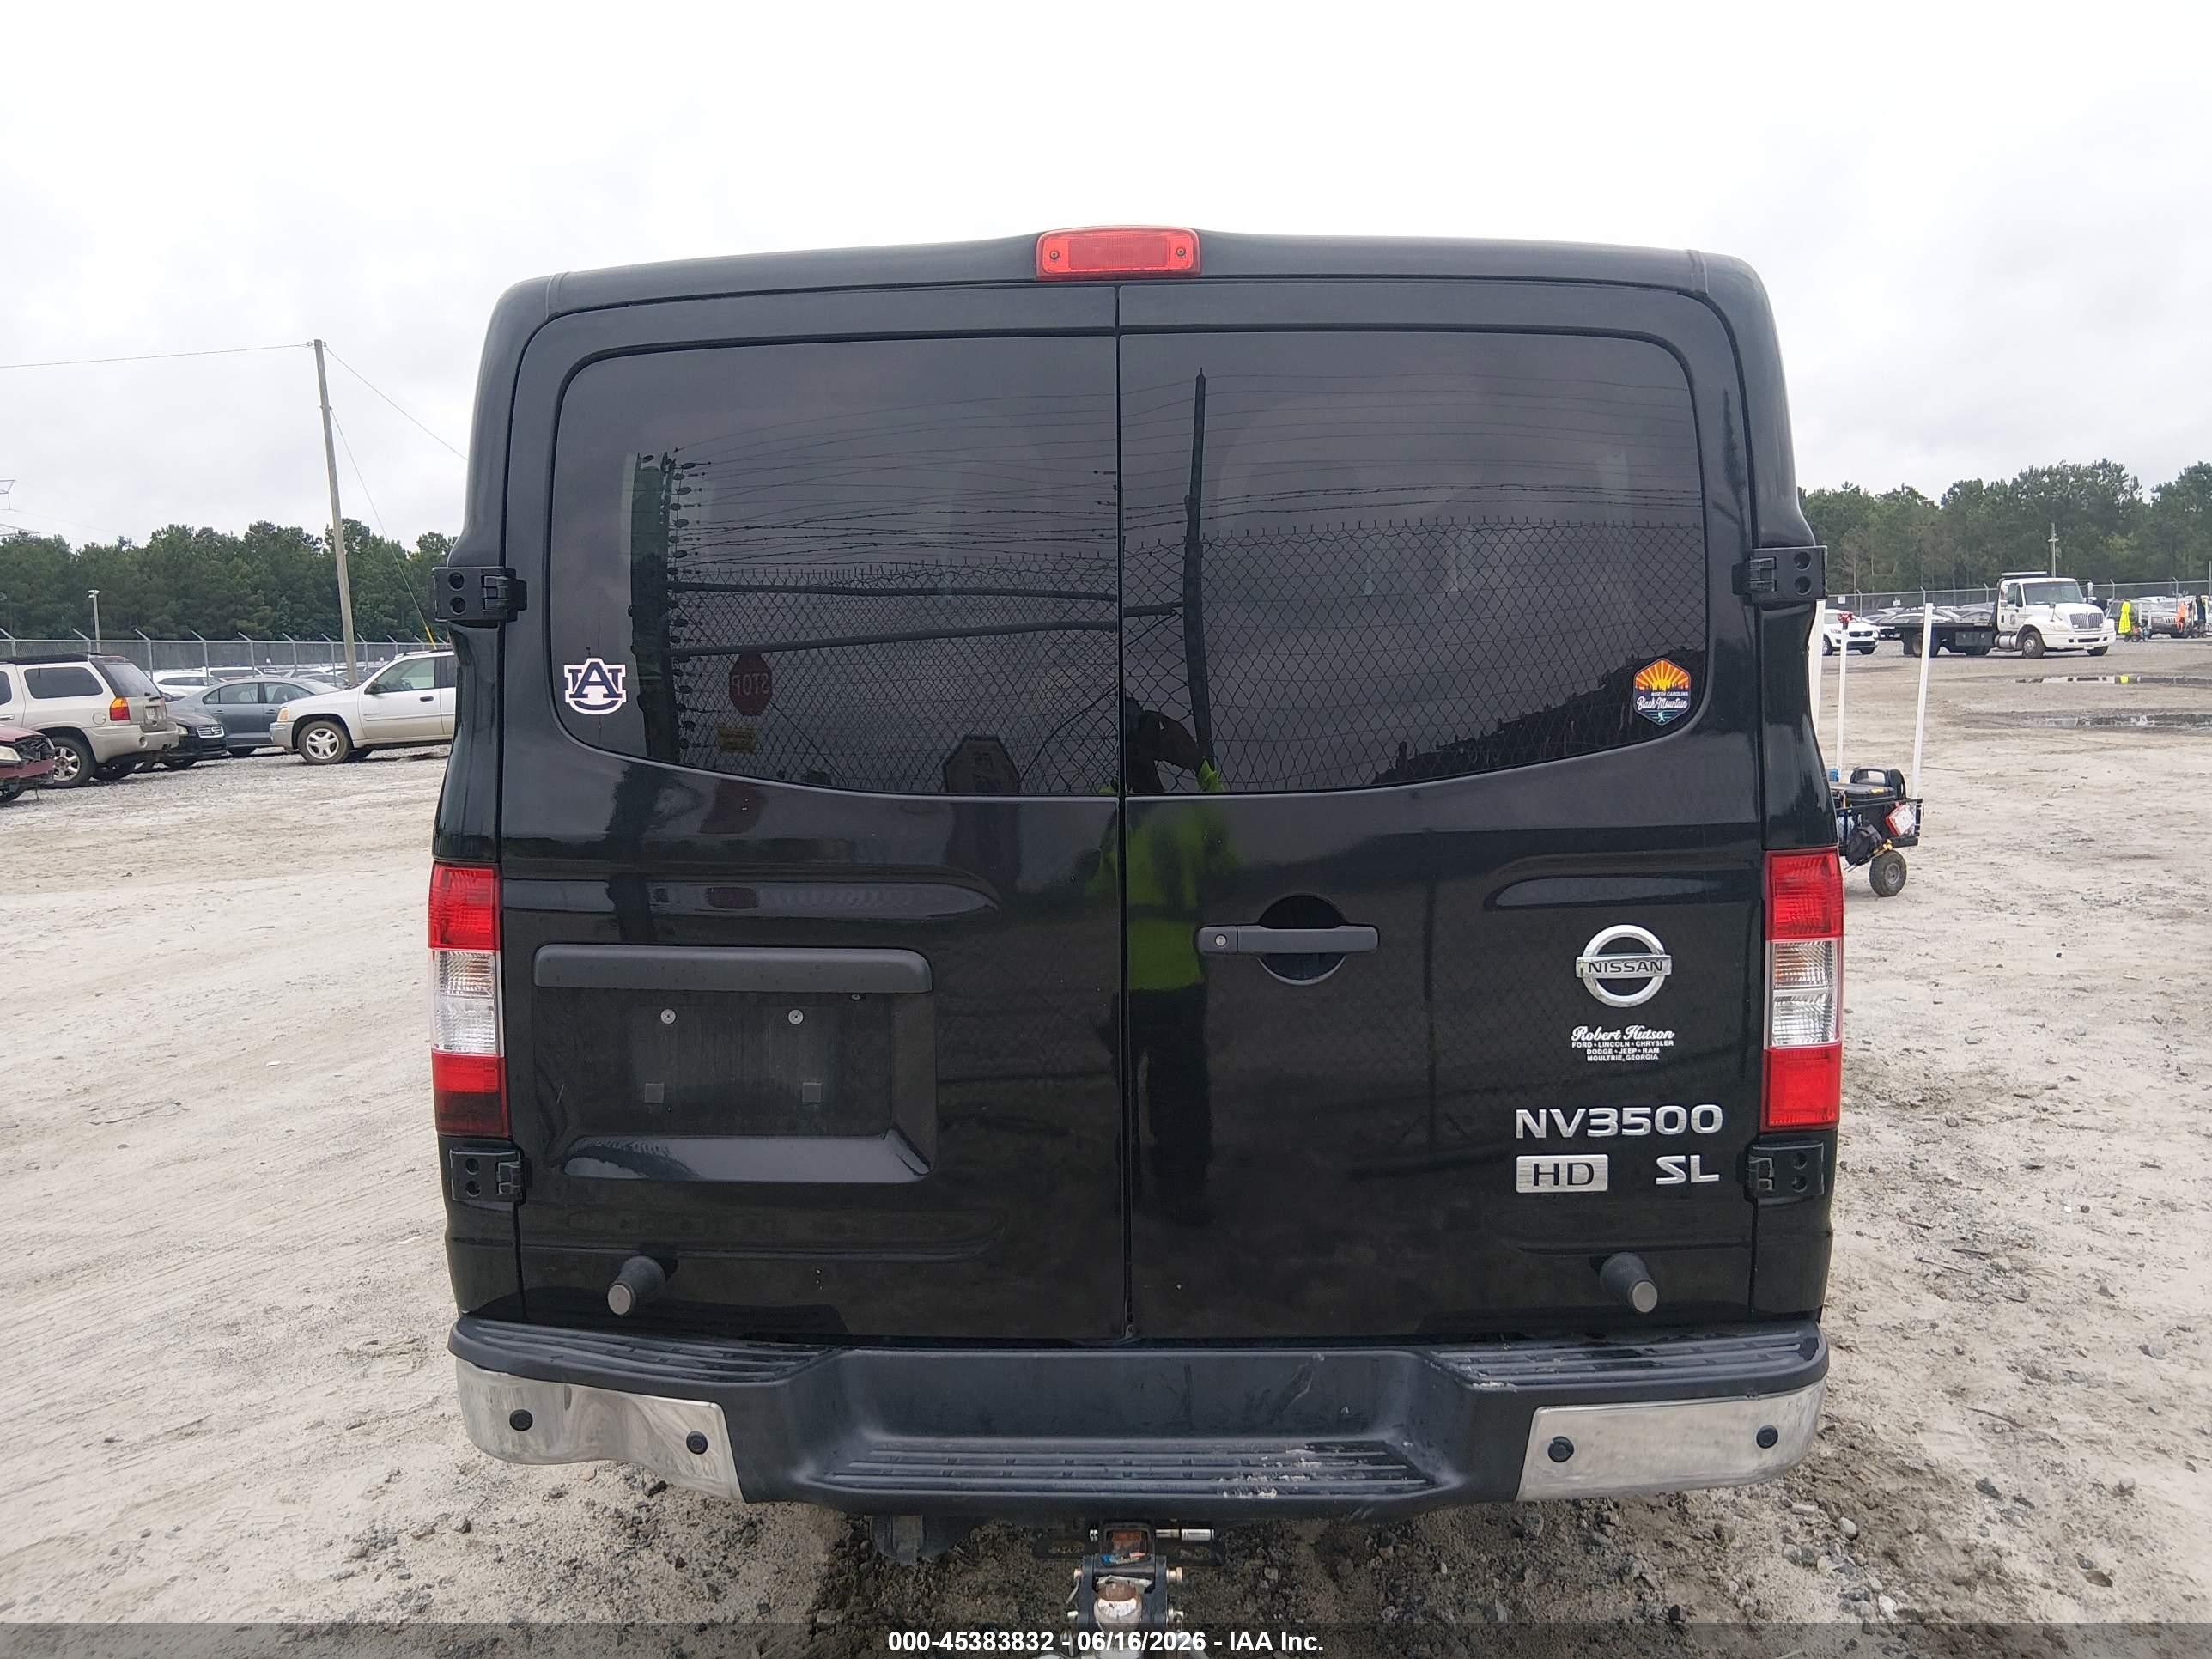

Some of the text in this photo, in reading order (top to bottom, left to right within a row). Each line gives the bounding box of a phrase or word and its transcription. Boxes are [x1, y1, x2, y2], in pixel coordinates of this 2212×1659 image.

[1637, 696, 1688, 710] Black Mountain
[1588, 960, 1663, 974] NISSAN
[1571, 1025, 1675, 1041] Robert Hutson
[1515, 1104, 1723, 1139] NV3500
[1532, 1162, 1595, 1187] HD
[1655, 1154, 1720, 1185] SL
